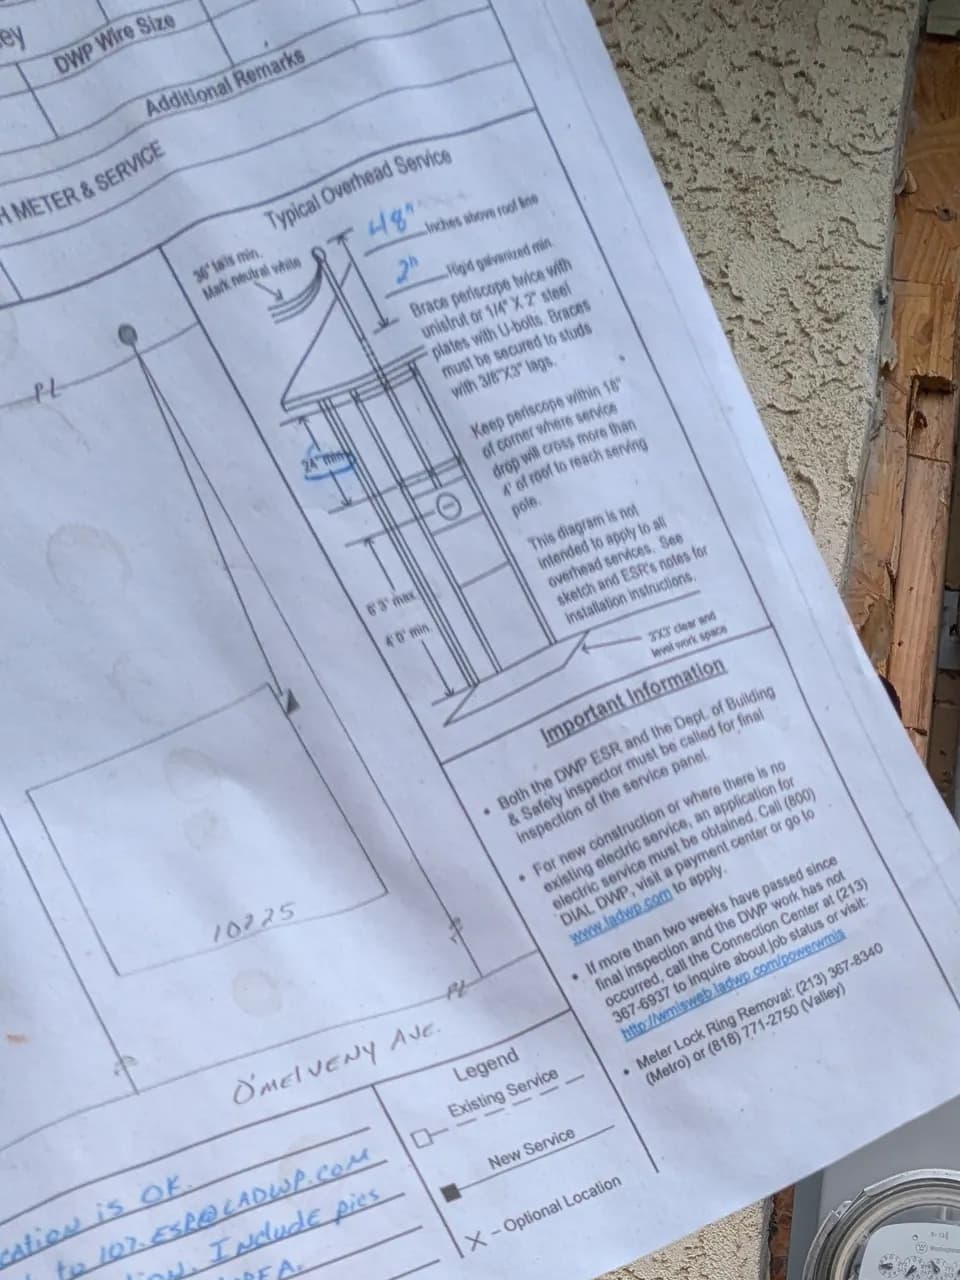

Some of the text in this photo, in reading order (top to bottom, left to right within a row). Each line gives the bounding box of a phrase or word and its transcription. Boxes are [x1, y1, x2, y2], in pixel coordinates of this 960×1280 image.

[54, 14, 176, 74] DWP Wire Size
[145, 48, 306, 118] Additional Remarks
[11, 186, 81, 221] METER
[80, 181, 95, 199] &
[94, 140, 166, 192] SERVICE
[263, 149, 453, 231] Typical Overhead Service
[408, 257, 573, 319] Brace periscope twice with
[469, 416, 505, 440] Keep
[505, 396, 566, 428] periscope
[564, 385, 603, 407] within
[526, 503, 640, 551] This diagram is not
[547, 558, 604, 589] overhead
[658, 533, 684, 550] See
[556, 581, 598, 607] sketch
[596, 572, 621, 592] and
[658, 551, 692, 571] notes
[690, 545, 708, 560] for
[564, 593, 629, 625] installation
[539, 658, 729, 748] Important Information
[496, 787, 531, 811] Both
[529, 777, 554, 795] the
[553, 757, 588, 784] DWP
[589, 741, 624, 767] ESR
[623, 728, 651, 751] and
[649, 722, 673, 739] the
[710, 699, 725, 718] of
[724, 685, 777, 712] Building
[515, 805, 584, 845] inspection
[584, 794, 599, 813] of
[597, 787, 621, 806] the
[622, 765, 670, 794] service
[531, 760, 787, 878] For new construction or where there is no
[567, 887, 675, 947] www.ladwp.com
[671, 880, 688, 895] to
[584, 855, 838, 976] If more than two weeks have passed since
[594, 869, 847, 992] final inspection and the DWP work has not
[635, 942, 884, 1071] Meter Lock Ring Removal: (213) 367-8340
[645, 981, 846, 1087] (Metro) or (818) 771-2750 (Valley)
[447, 1069, 559, 1119] Existing Service
[452, 1046, 520, 1083] Legend
[487, 1128, 576, 1171] New Service
[503, 1199, 564, 1232] Optional
[562, 1176, 623, 1208] Location
